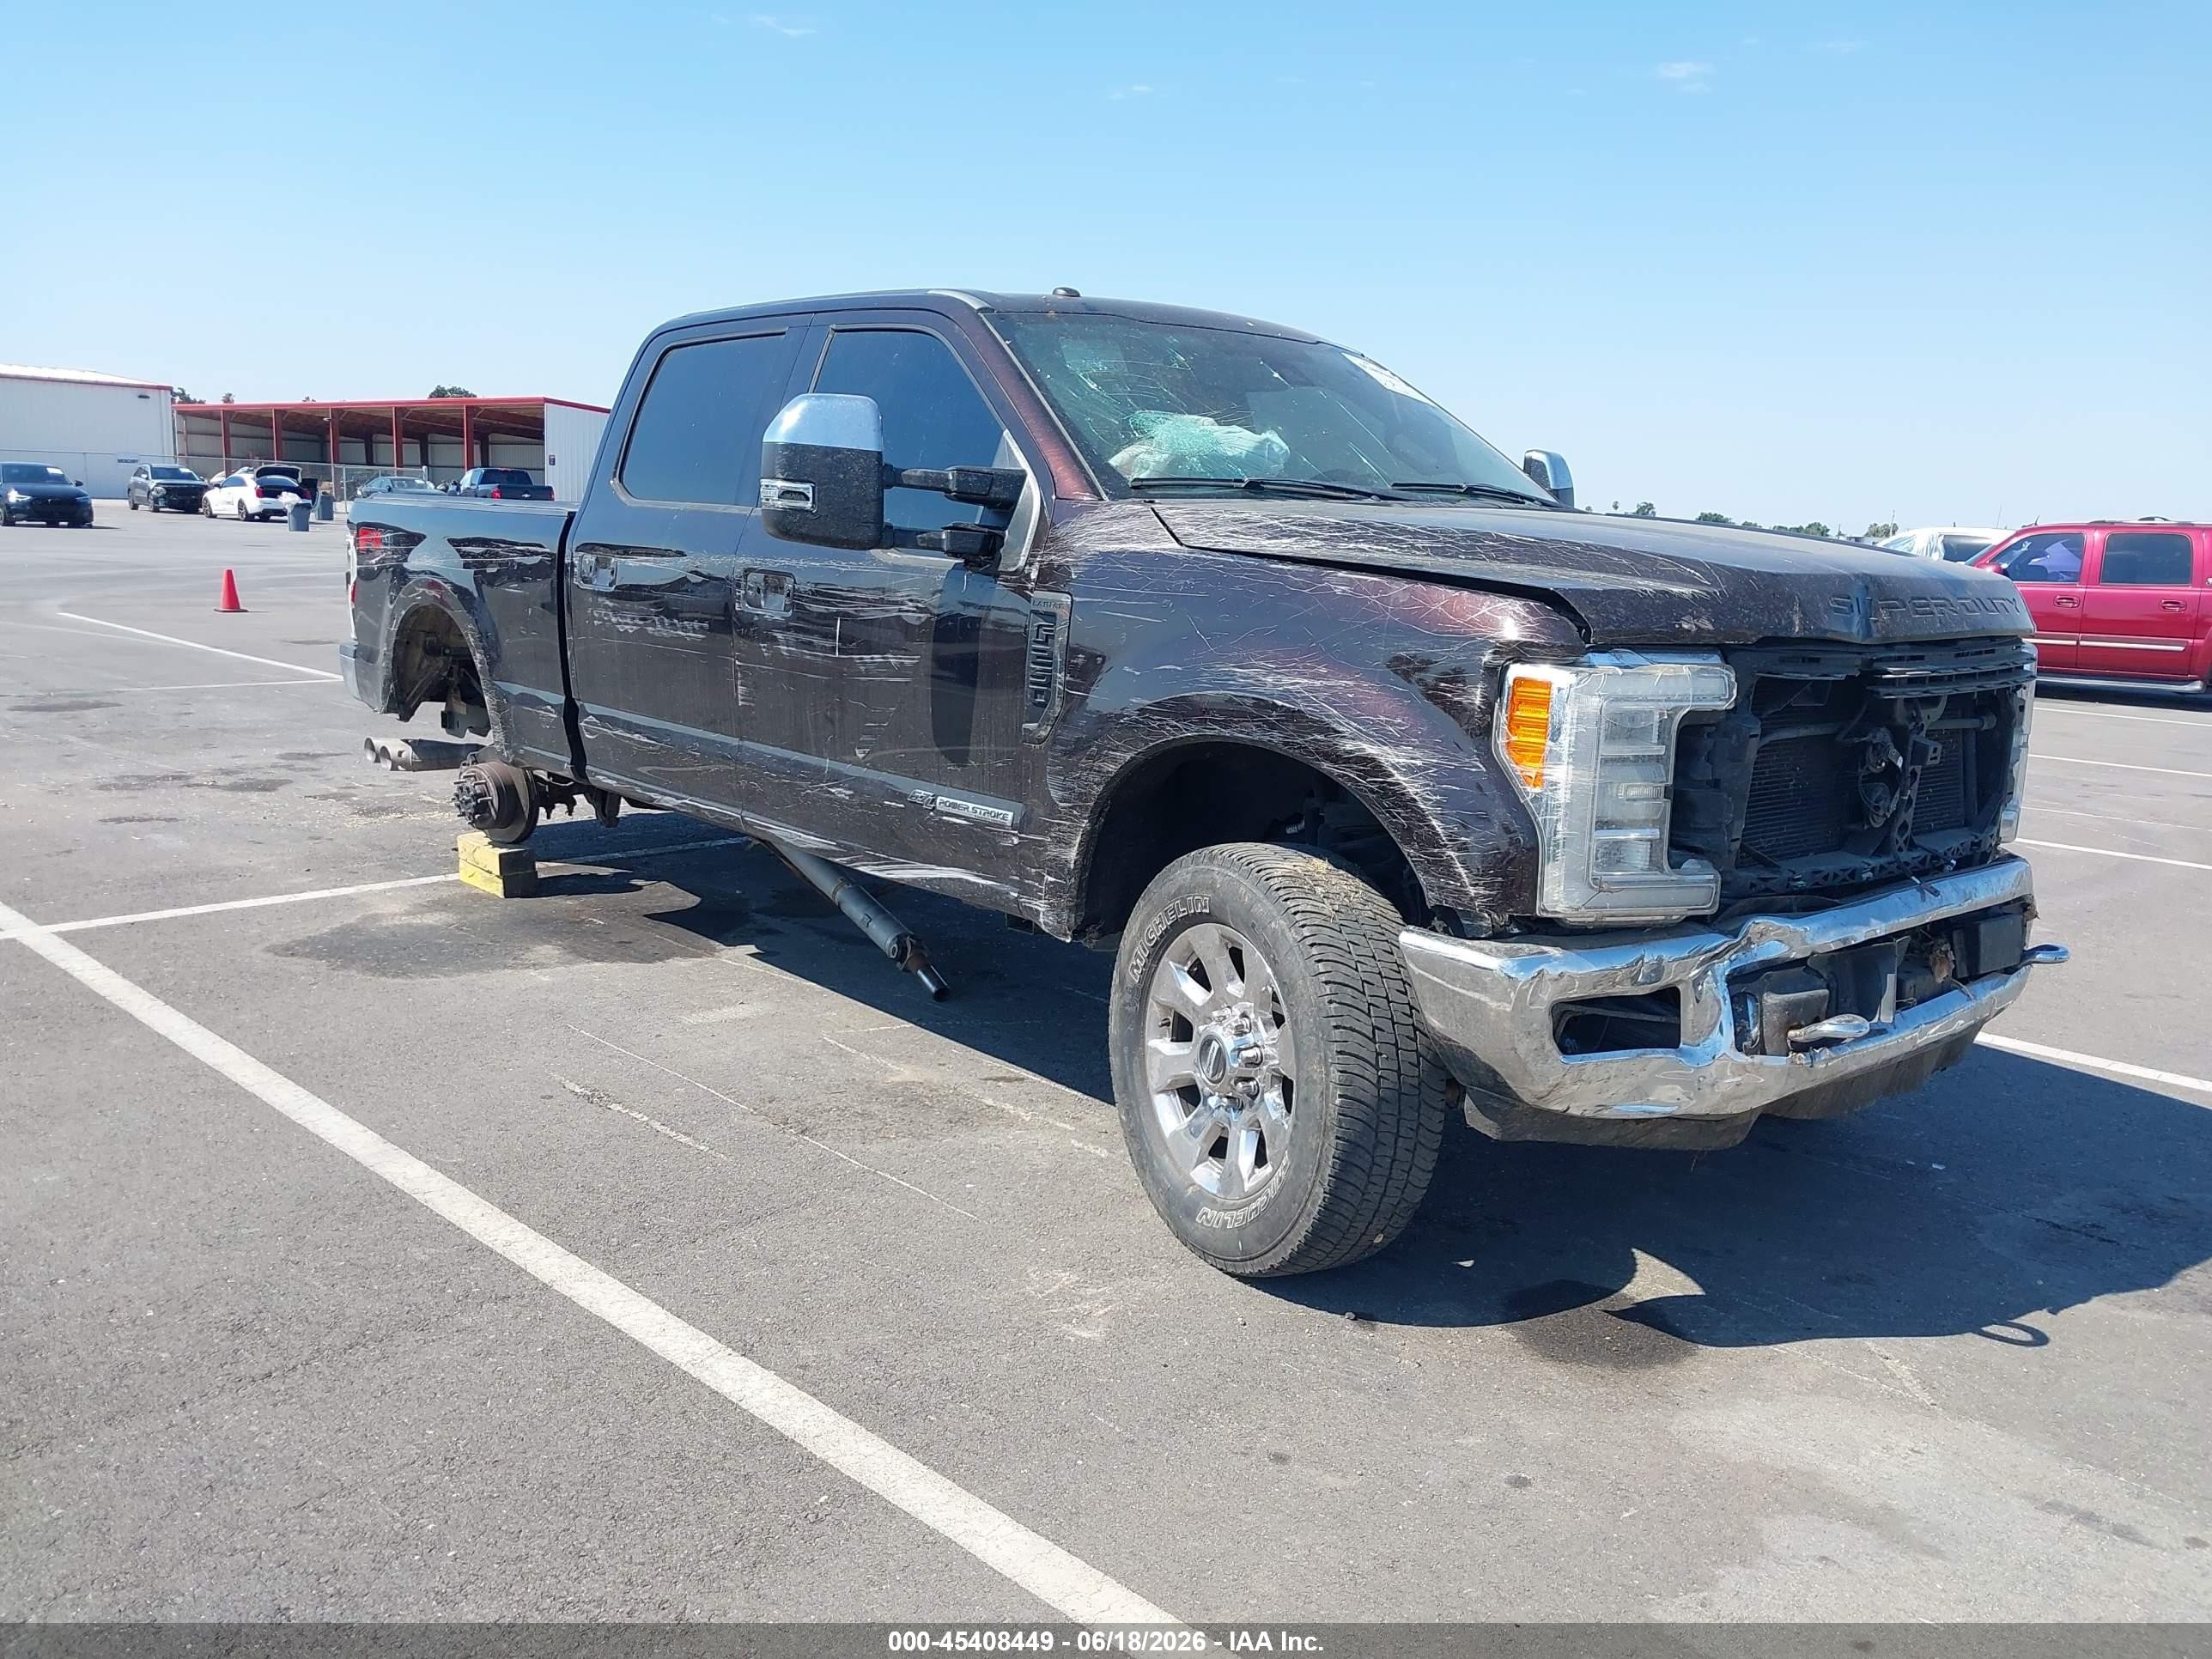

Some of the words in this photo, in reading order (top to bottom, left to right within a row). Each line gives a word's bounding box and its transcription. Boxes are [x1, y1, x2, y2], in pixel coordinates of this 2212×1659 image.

[1828, 594, 1959, 620] SUPER
[1957, 597, 2021, 616] DUTY
[939, 799, 970, 812] POWER
[971, 805, 1010, 822] STROKE
[1128, 896, 1211, 983] MICHELIN
[1195, 1150, 1291, 1229] MICHELIN
